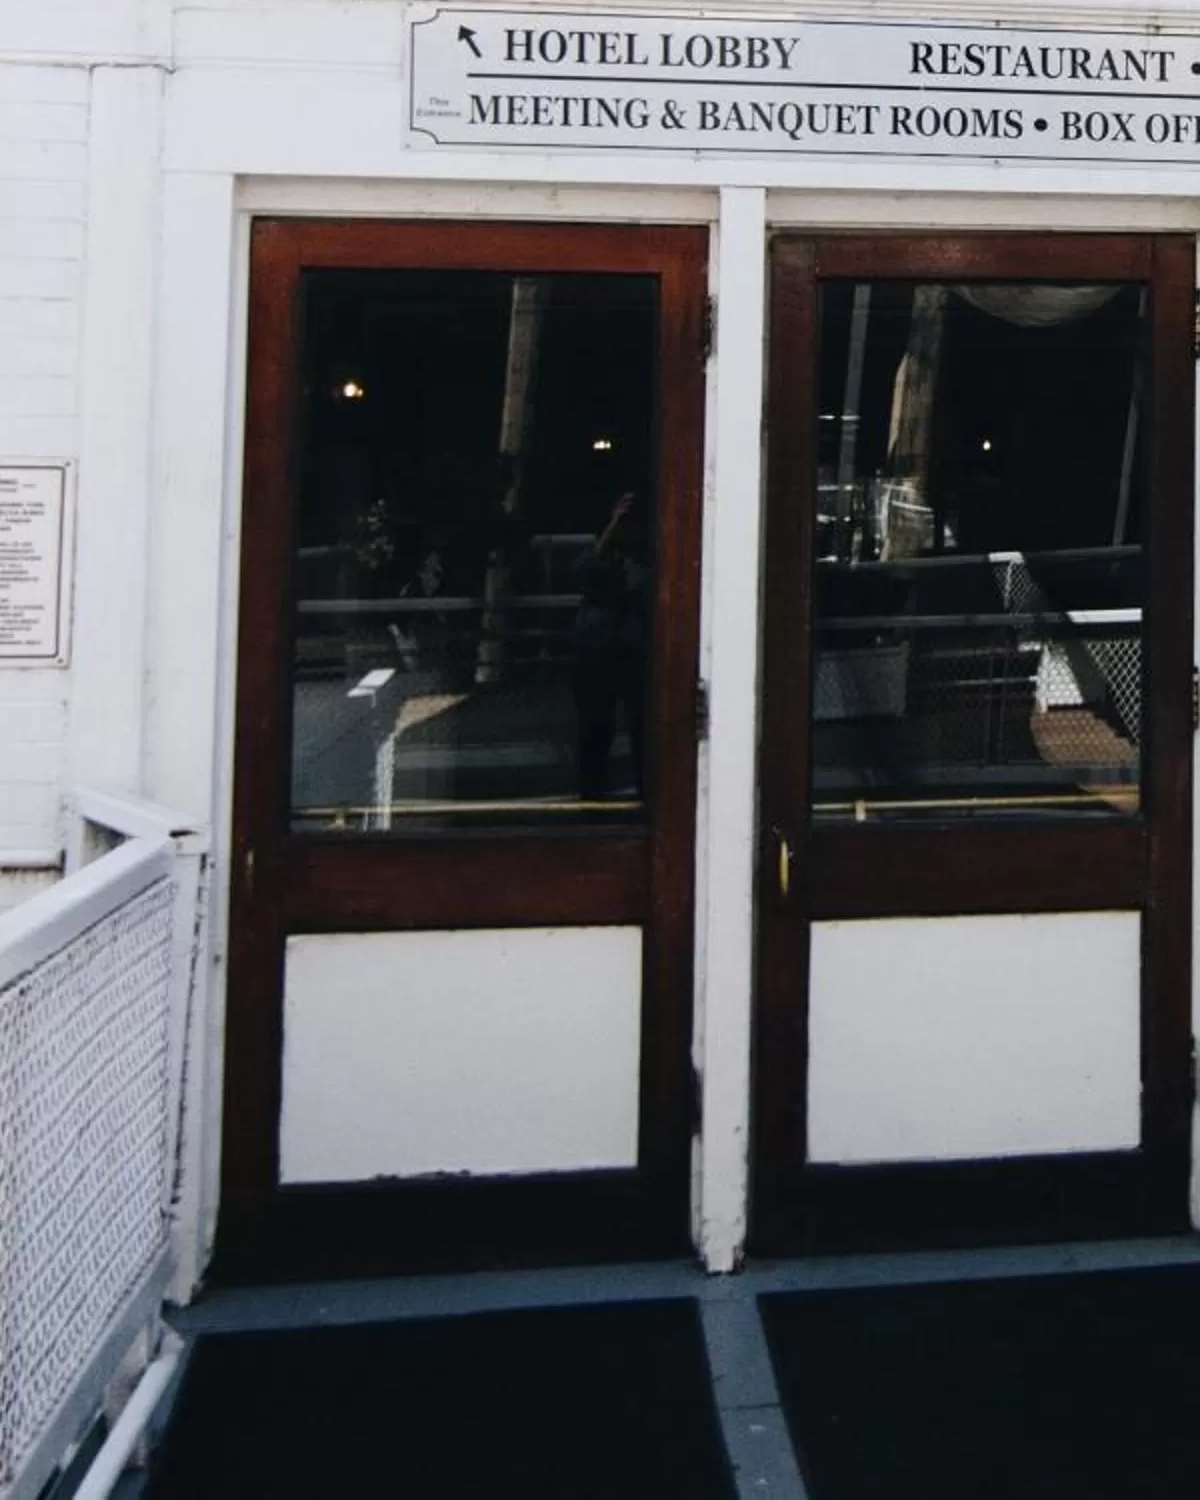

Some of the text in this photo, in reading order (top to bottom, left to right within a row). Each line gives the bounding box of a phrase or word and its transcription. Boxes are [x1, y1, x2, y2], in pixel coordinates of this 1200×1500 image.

[504, 29, 800, 70] HOTEL LOBBY
[910, 41, 1175, 83] RESTAURANT
[469, 94, 650, 130] MEETING
[660, 99, 686, 130] &
[698, 101, 880, 141] BANQUET
[890, 106, 1024, 140] ROOMS
[1061, 111, 1135, 143] BOX
